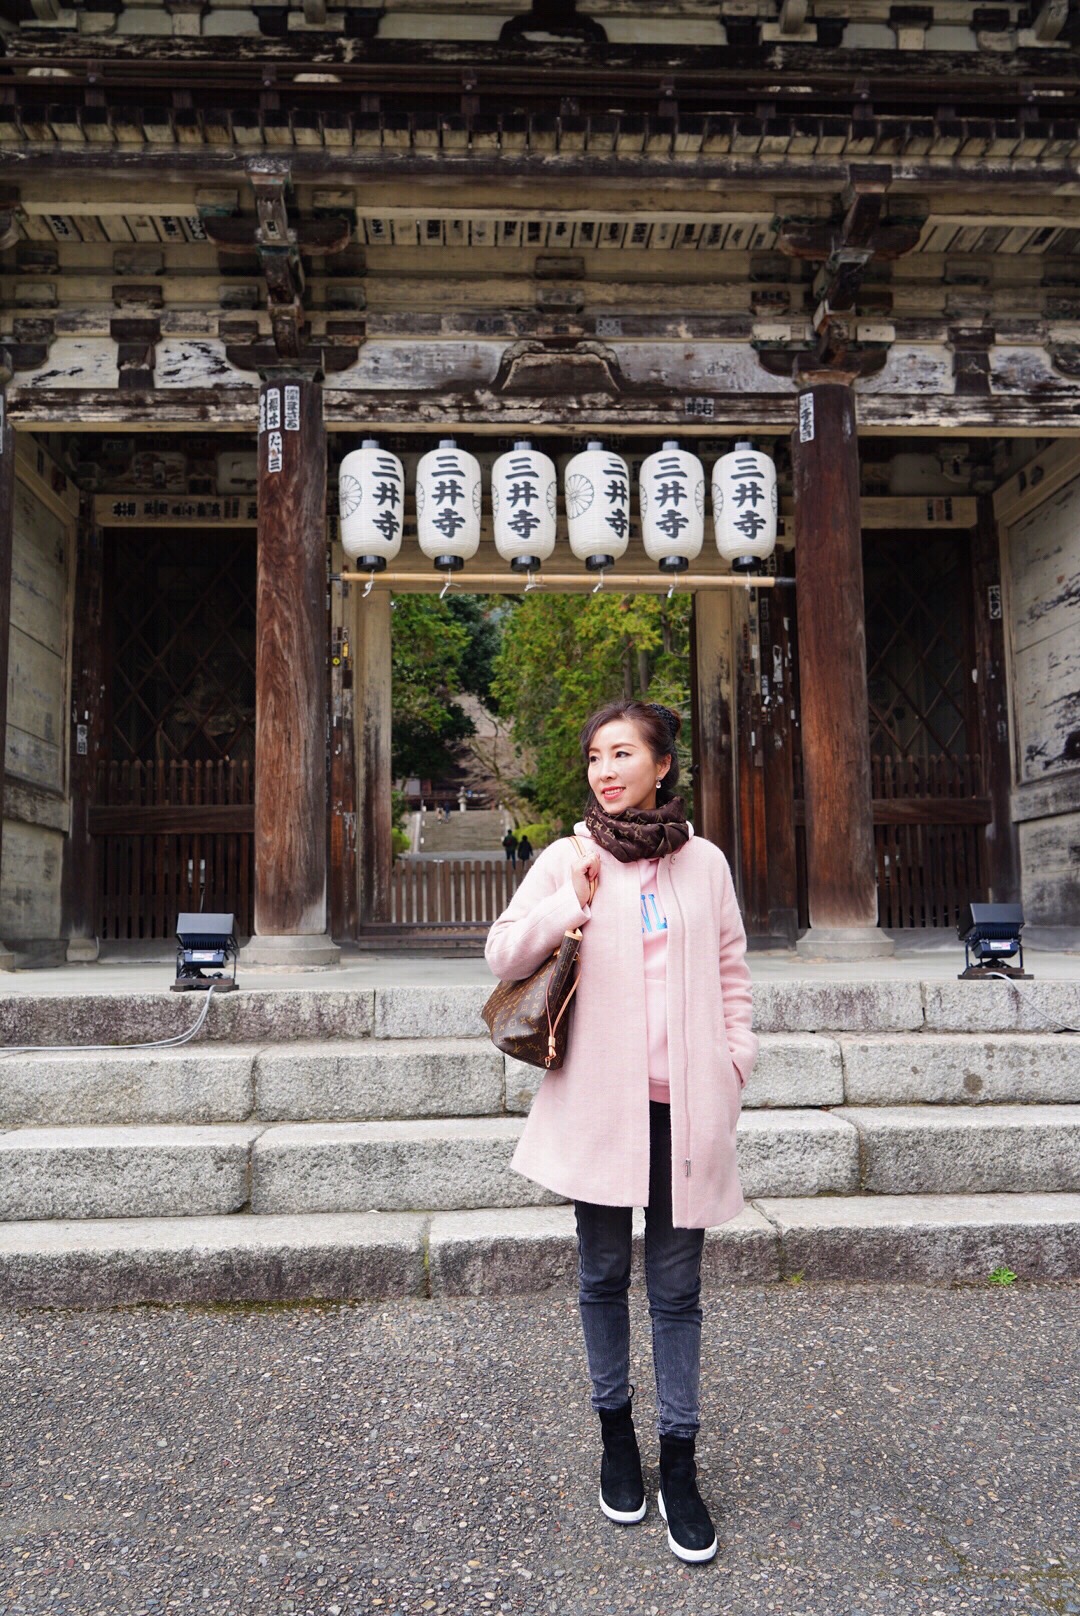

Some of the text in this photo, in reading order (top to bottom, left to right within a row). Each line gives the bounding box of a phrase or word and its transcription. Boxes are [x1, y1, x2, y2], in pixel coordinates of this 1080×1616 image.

[372, 456, 401, 541] 三井寺
[431, 455, 466, 539] 三井寺
[505, 456, 541, 540] 三井寺
[603, 457, 628, 539] 三井寺
[653, 456, 690, 539] 三井寺
[730, 456, 767, 540] 三井寺
